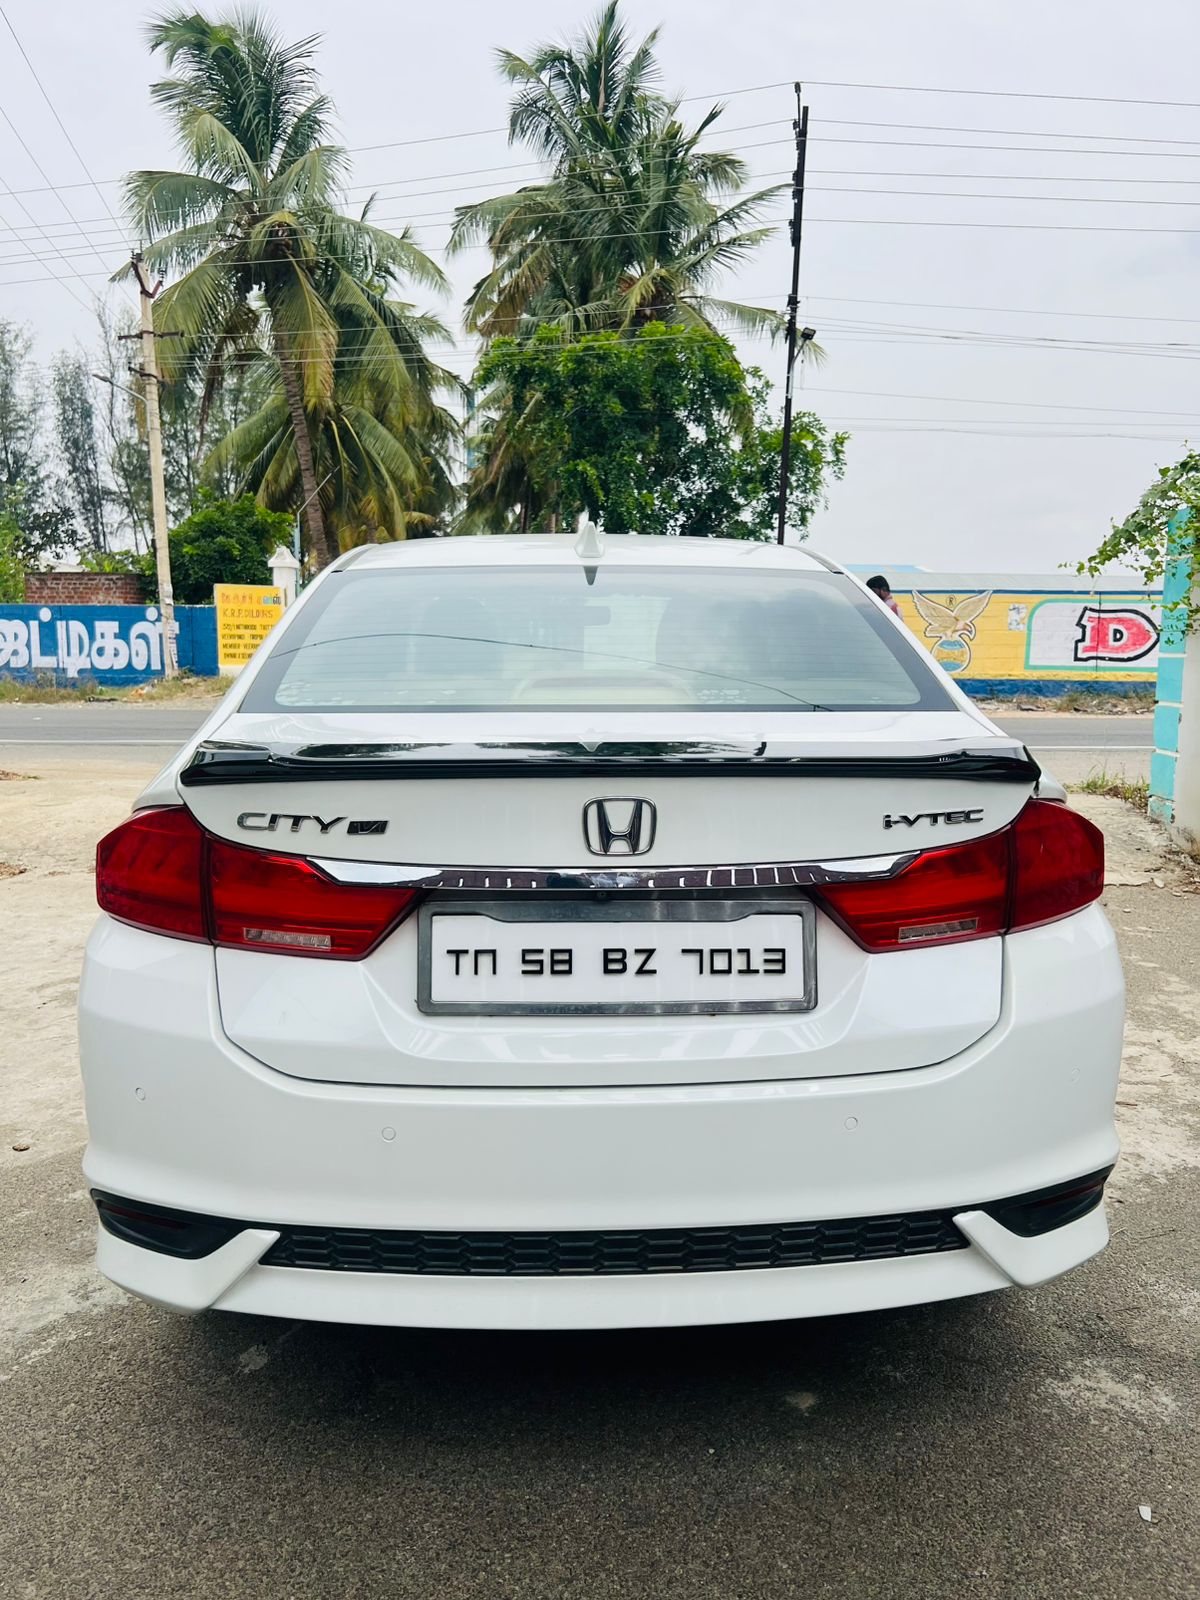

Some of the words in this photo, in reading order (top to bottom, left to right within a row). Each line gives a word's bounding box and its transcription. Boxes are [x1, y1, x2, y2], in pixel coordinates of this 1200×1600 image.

[237, 812, 348, 834] CITY
[883, 808, 984, 829] i-VTEC
[521, 948, 573, 975] 58
[602, 948, 657, 975] BZ
[681, 948, 786, 975] 7013
